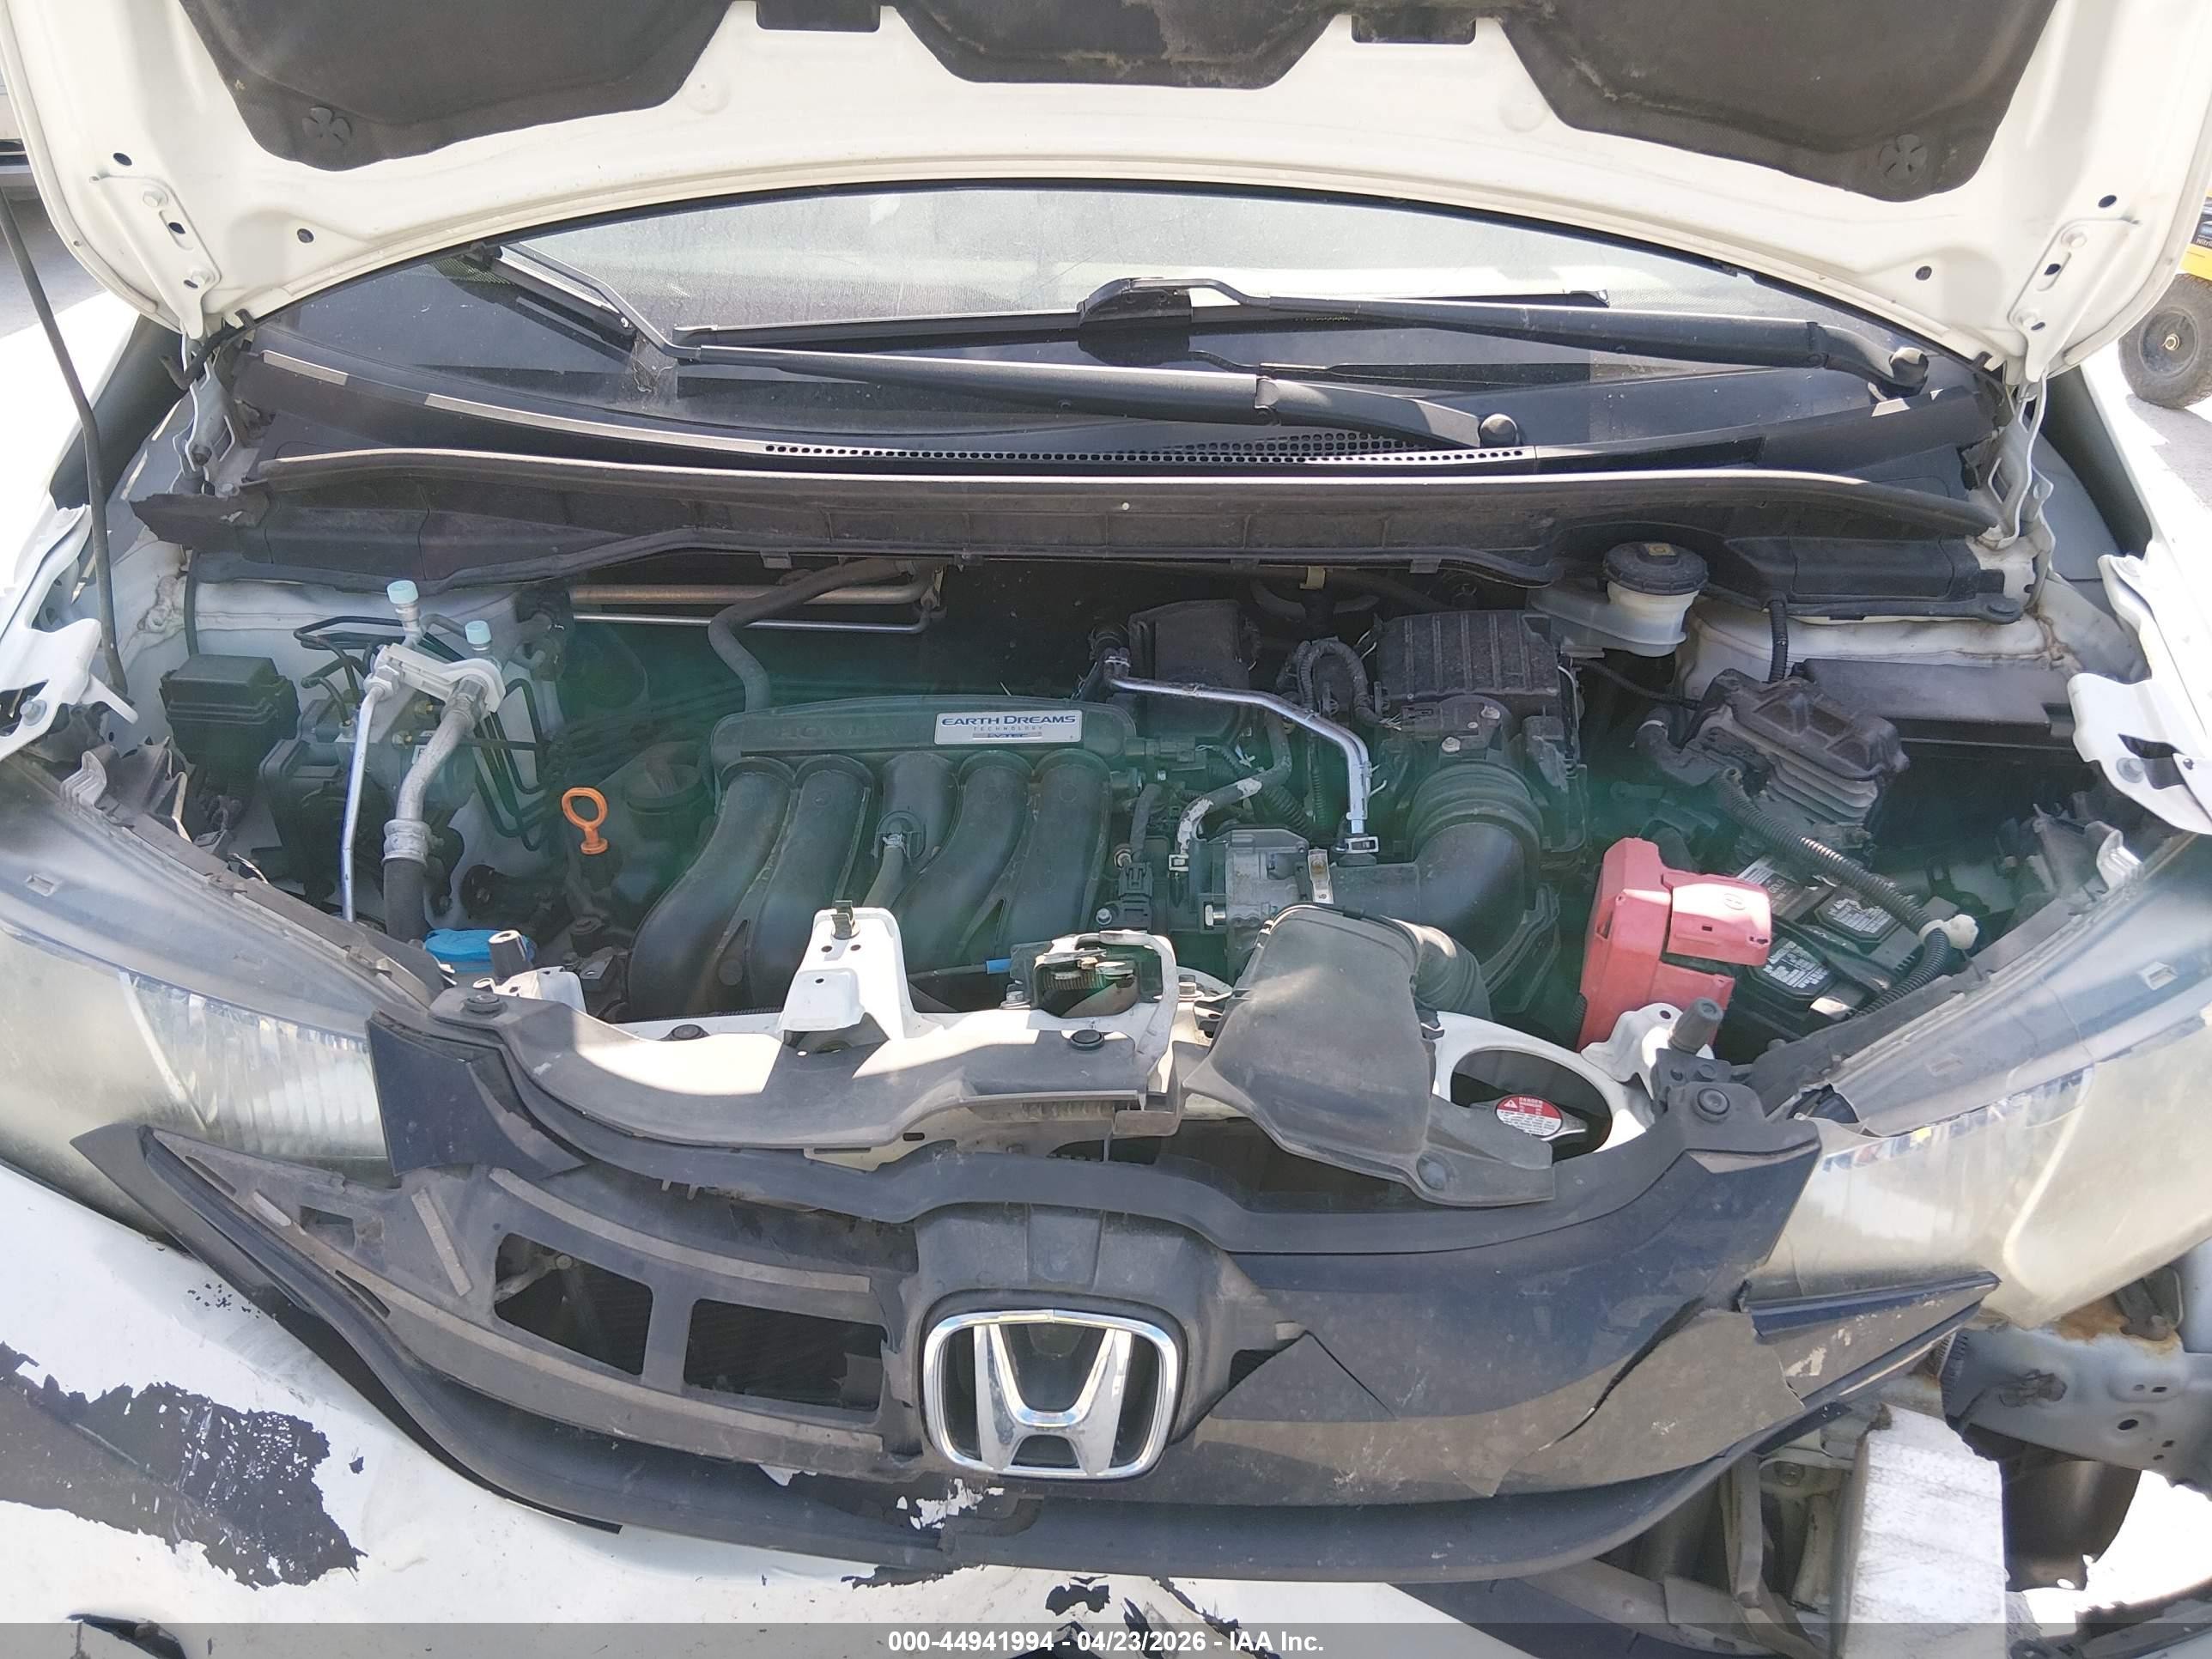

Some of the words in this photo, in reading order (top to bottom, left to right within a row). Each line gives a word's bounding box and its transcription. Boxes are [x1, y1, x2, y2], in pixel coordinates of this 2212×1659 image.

[941, 717, 1000, 726] EARTH
[1003, 715, 1076, 725] DREAMS
[1767, 878, 1786, 893] GOLD
